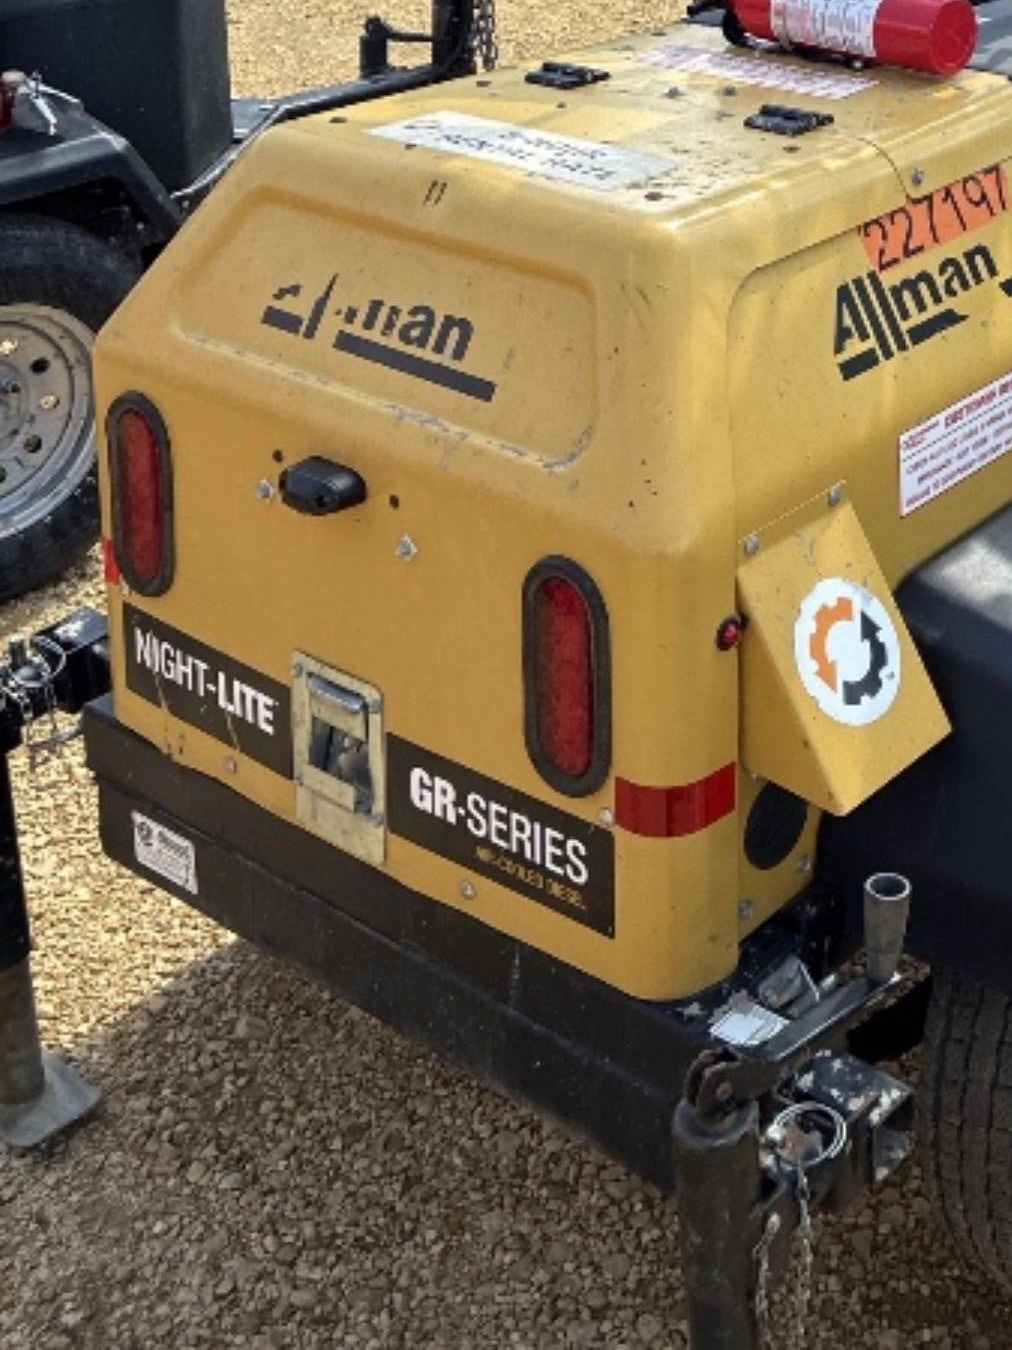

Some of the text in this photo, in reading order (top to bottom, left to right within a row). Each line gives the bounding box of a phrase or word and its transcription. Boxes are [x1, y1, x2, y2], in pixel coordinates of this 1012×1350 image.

[858, 165, 1009, 272] 227197
[133, 626, 276, 736] NIGHT-LITE
[408, 766, 591, 886] GR-SERIES
